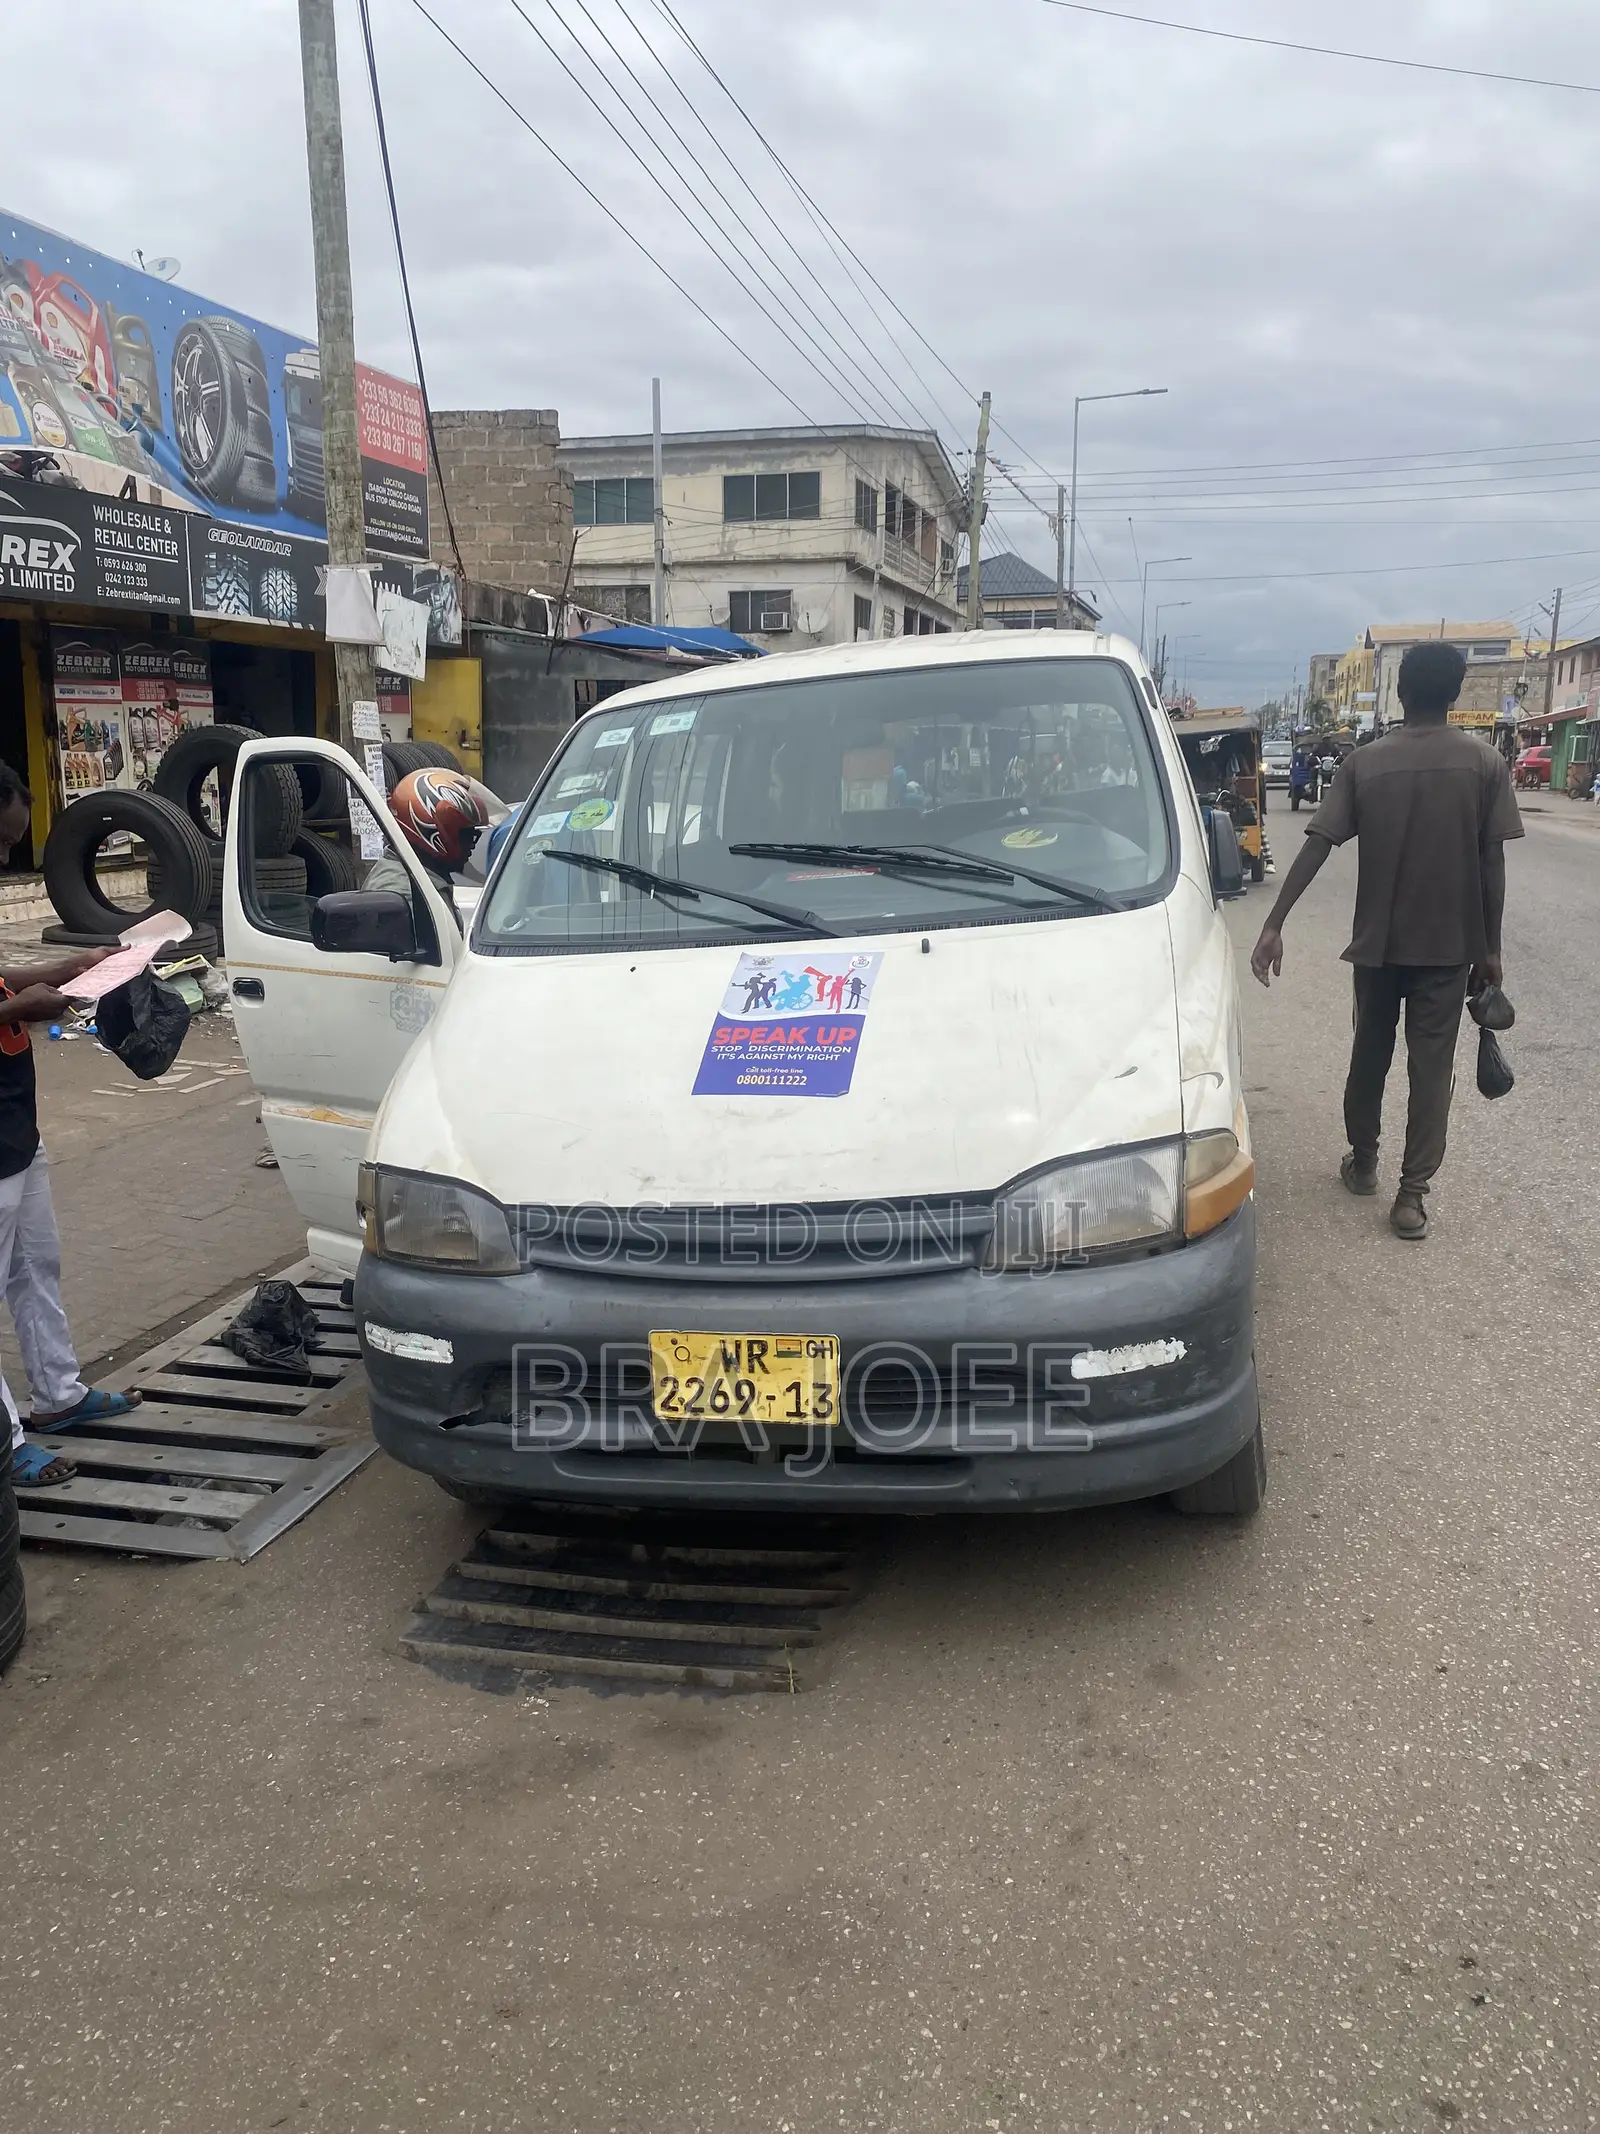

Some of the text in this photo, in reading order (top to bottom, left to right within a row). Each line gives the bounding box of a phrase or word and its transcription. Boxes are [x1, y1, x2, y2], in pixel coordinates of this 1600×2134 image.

[358, 378, 377, 401] +233
[388, 389, 403, 411] 362
[361, 402, 422, 439] +233 24 212 3333
[363, 425, 381, 447] +233
[381, 430, 392, 450] 30
[392, 434, 405, 455] 267
[383, 477, 406, 490] LOCATION
[365, 492, 375, 502] BUS
[376, 496, 388, 505] STOP
[386, 488, 404, 500] ZONGO
[93, 504, 172, 535] WHOLESALE &
[94, 527, 179, 557] RETAIL CENTER
[207, 528, 292, 557] GEOLANDAR
[95, 556, 147, 573] T: 0593 626 300
[10, 567, 75, 593] LIMITED
[104, 572, 148, 588] 0242 123 333
[97, 586, 181, 605] E: Zebrextitan@gmail.com
[56, 654, 111, 668] ZEBREX
[56, 665, 112, 675] MOTORS LIMITED
[124, 655, 170, 667] ZEBREX
[125, 665, 171, 674] MOTORS LIMITED
[713, 1027, 857, 1046] SPEAK UP
[711, 1045, 852, 1053] STOP DISCRIMINATION
[787, 1053, 805, 1061] MY
[736, 1074, 808, 1086] 0800111222
[719, 1339, 771, 1374] WR
[806, 1339, 833, 1360] GH
[660, 1376, 833, 1419] 2269-13
